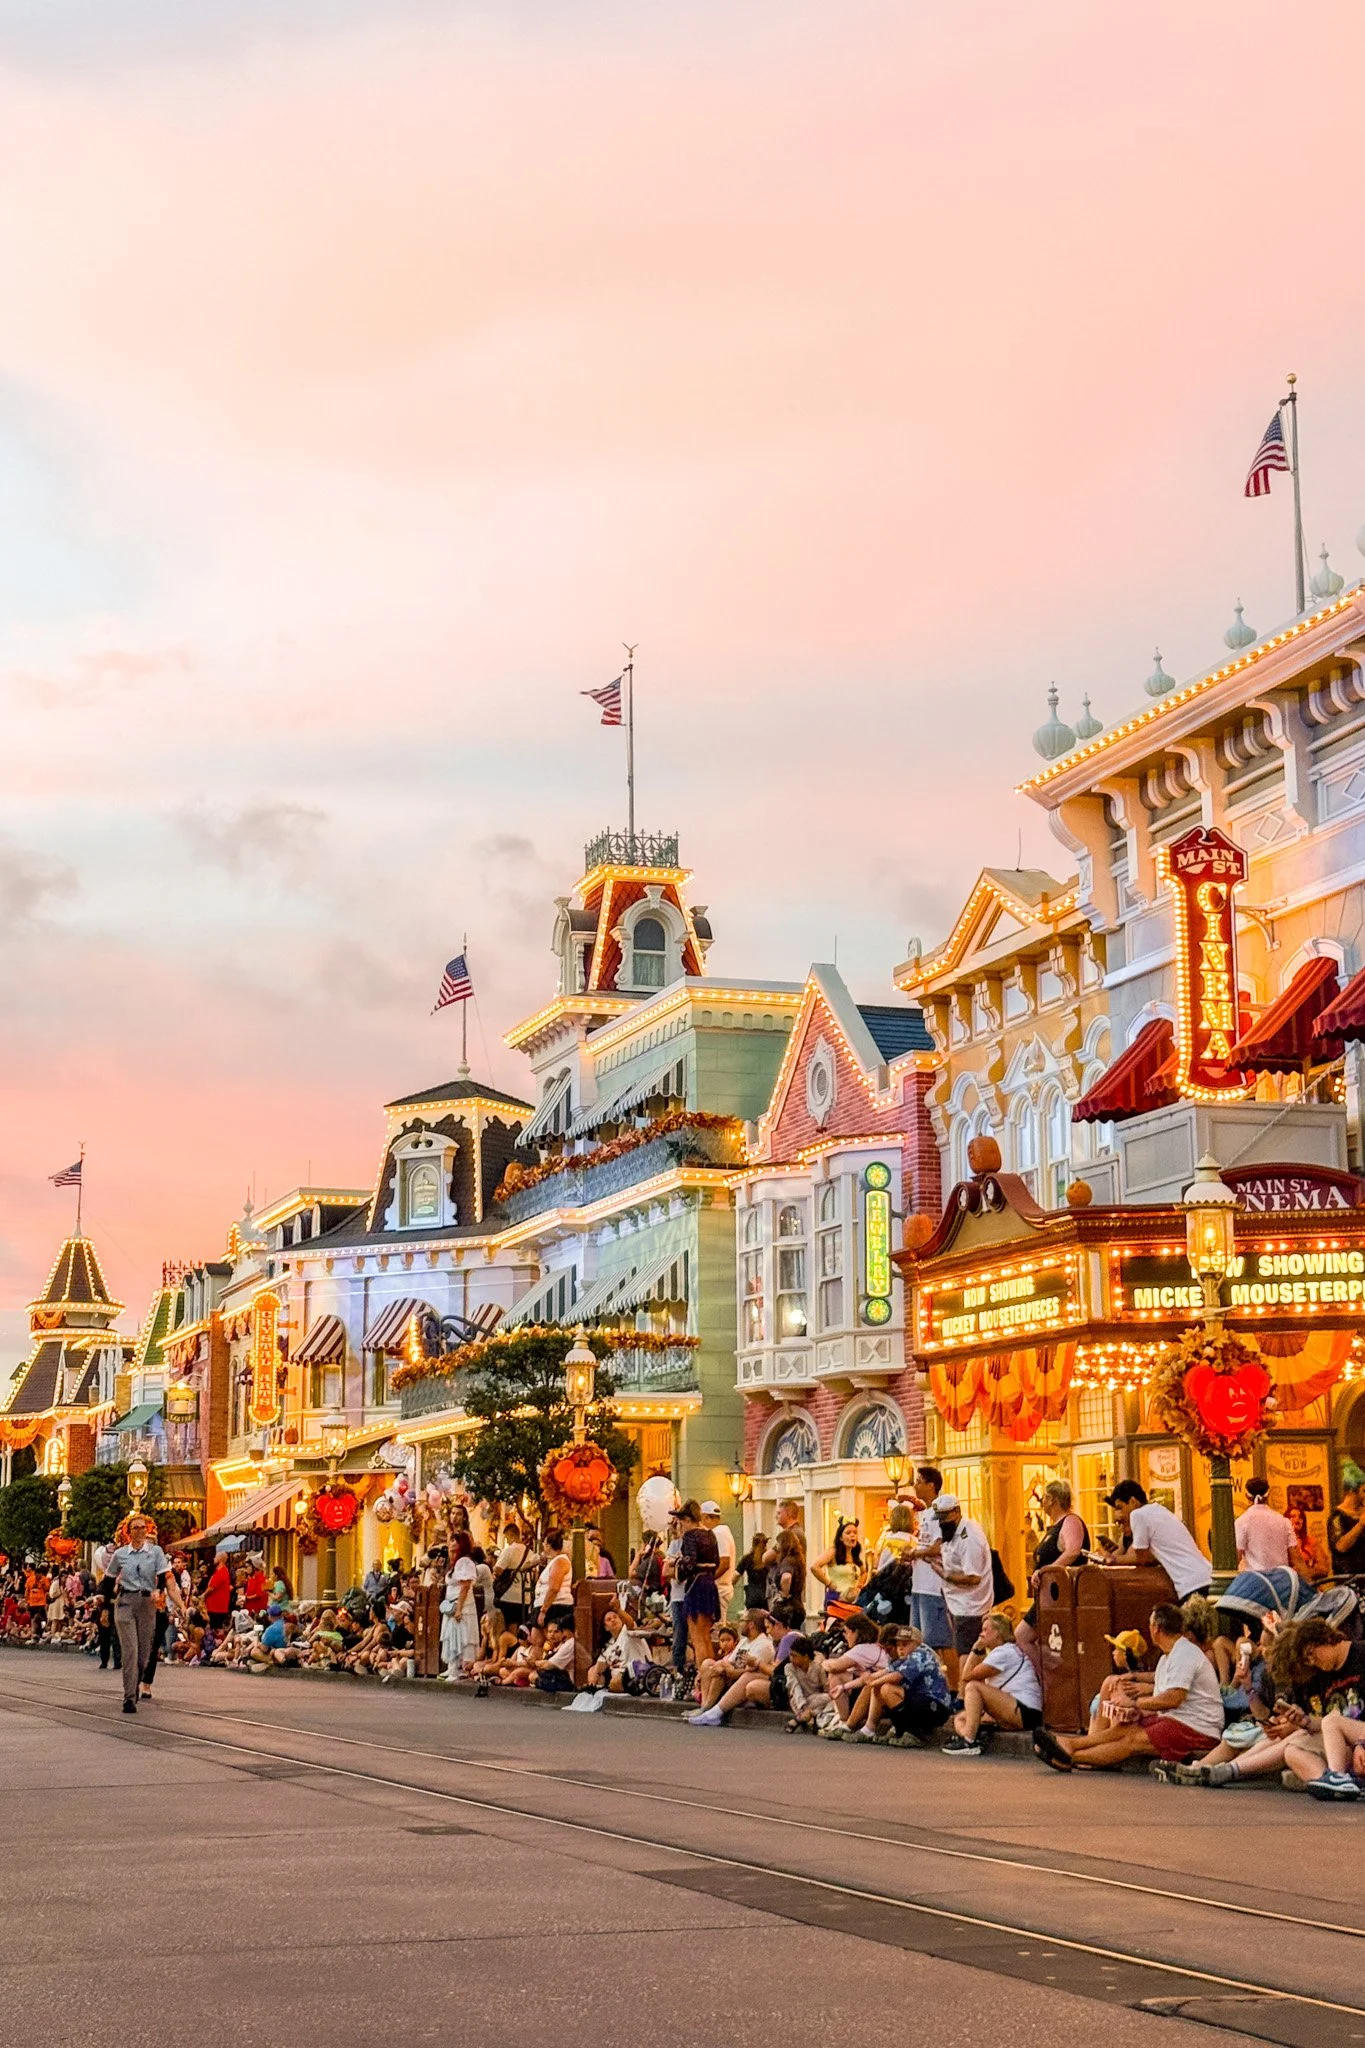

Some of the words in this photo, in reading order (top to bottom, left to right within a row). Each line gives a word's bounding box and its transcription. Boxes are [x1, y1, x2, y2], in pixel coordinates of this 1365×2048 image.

[1176, 848, 1235, 869] MAIN
[1212, 860, 1242, 876] ST.
[1197, 881, 1235, 1060] CINEMA
[1236, 1179, 1286, 1194] MAIN
[1244, 1185, 1350, 1213] NEMA
[869, 1194, 885, 1292] JEWELRY
[1258, 1251, 1365, 1277] SHOWING
[963, 1286, 986, 1309] NOW
[989, 1275, 1035, 1303] SHOWING
[1133, 1286, 1204, 1309] MICKE
[941, 1313, 976, 1337] MICKEY
[978, 1296, 1059, 1331] MOUSETERPIECES
